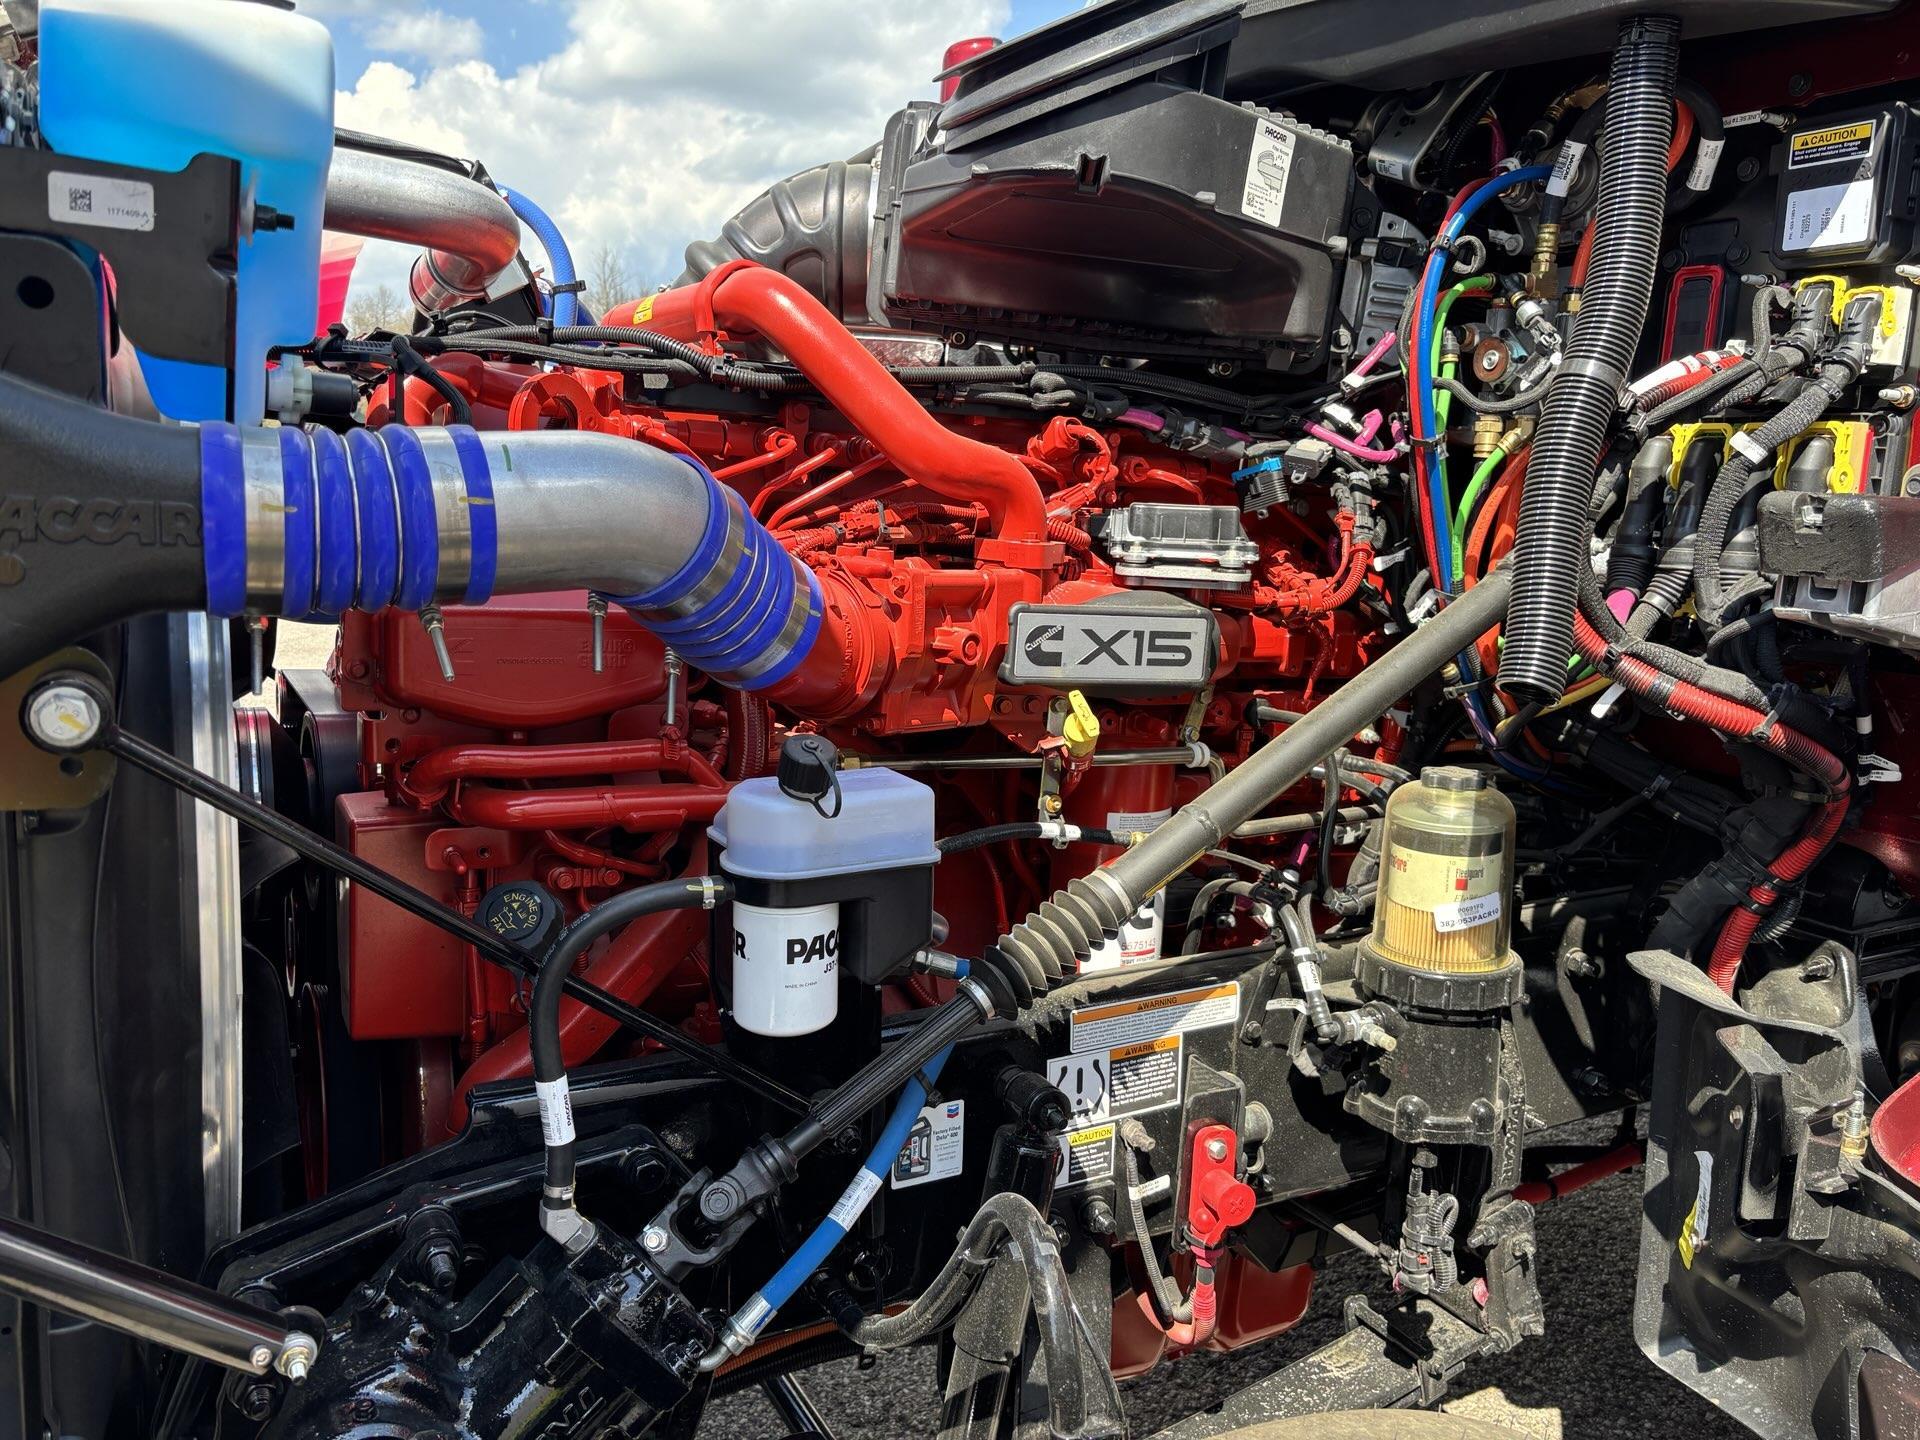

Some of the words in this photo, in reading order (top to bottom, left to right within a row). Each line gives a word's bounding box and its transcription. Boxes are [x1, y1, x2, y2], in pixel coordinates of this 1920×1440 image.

[1264, 126, 1288, 144] PACCAR
[1810, 128, 1857, 144] CAUTION
[1562, 154, 1576, 180] PACCAR
[0, 495, 202, 546] ACCAR
[1025, 624, 1062, 651] Cummins
[1076, 628, 1192, 666] X15
[504, 892, 538, 912] ENGINE
[523, 914, 537, 929] OIL
[786, 927, 840, 964] PAC
[823, 960, 837, 973] J37-
[1142, 996, 1176, 1008] WARNING
[1131, 1040, 1165, 1054] WARNING
[563, 1094, 572, 1127] PACCAR
[1078, 1128, 1112, 1142] CAUTION
